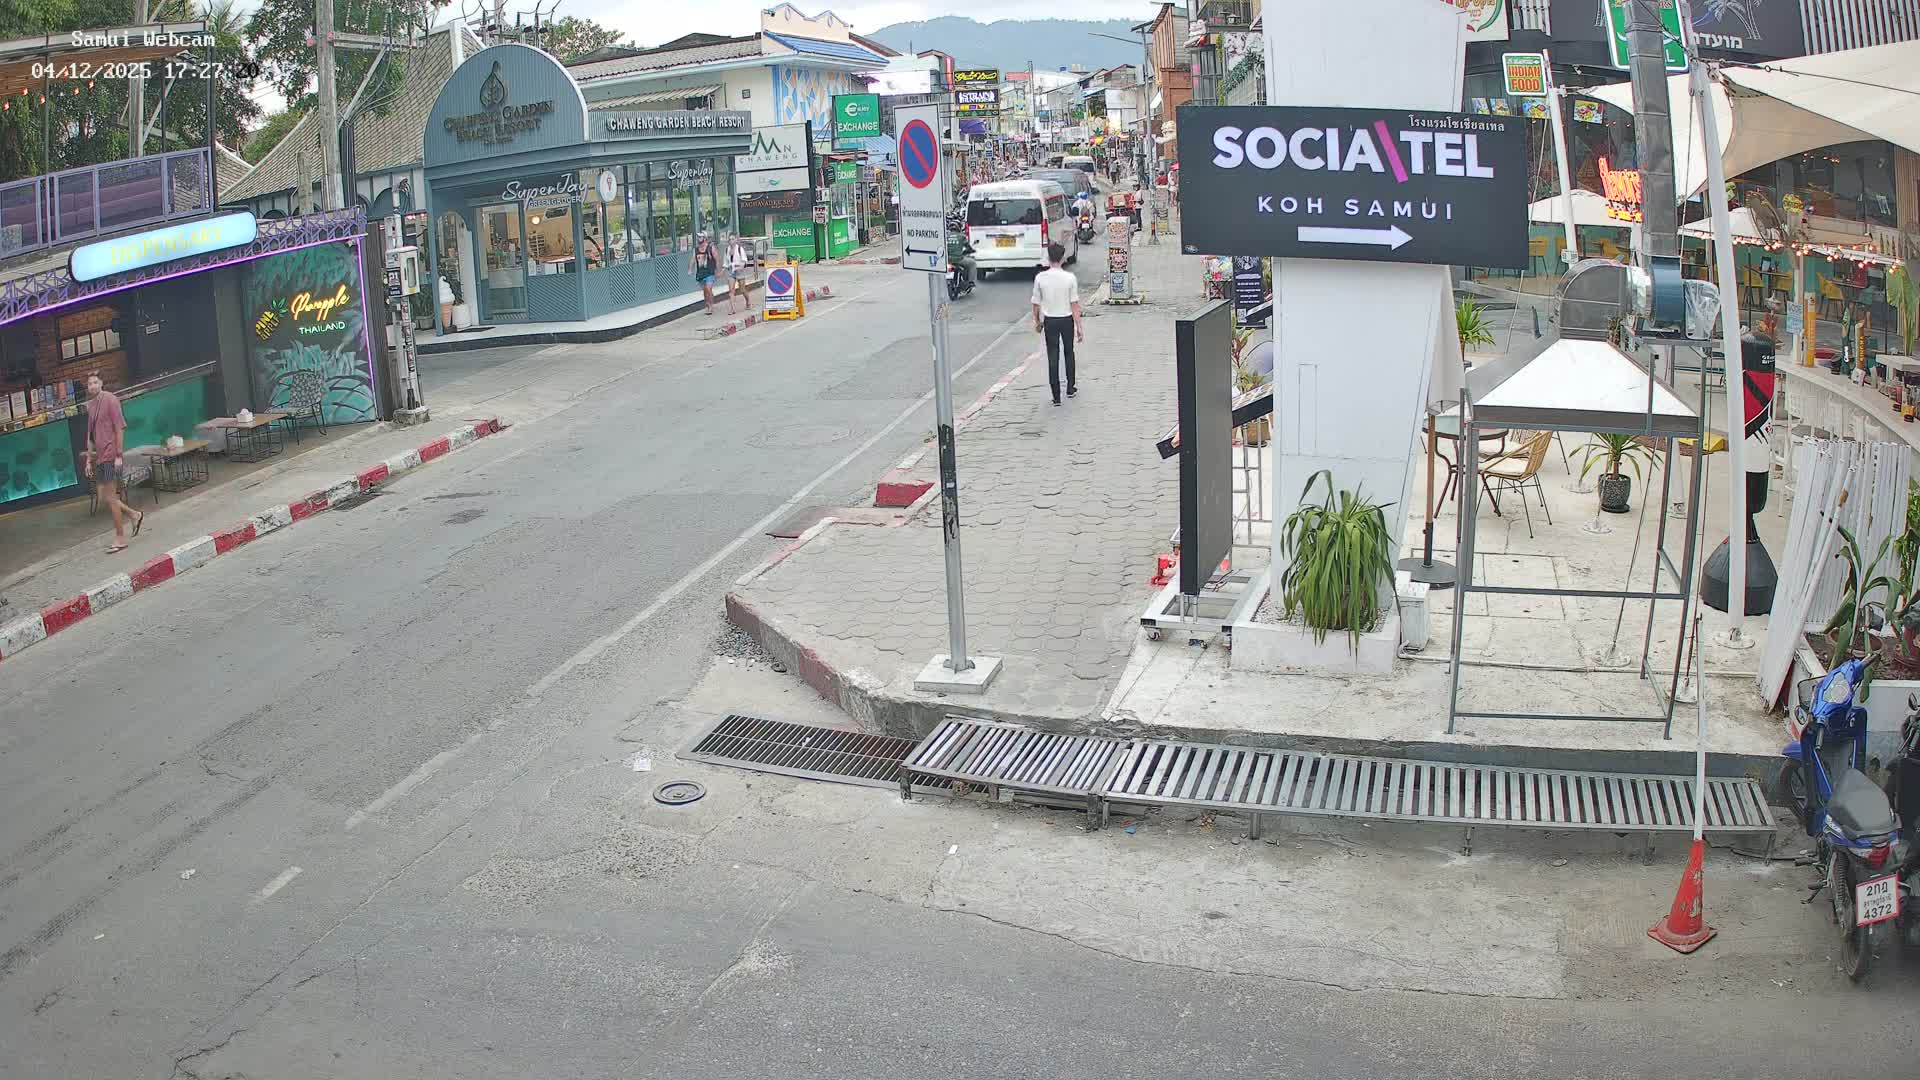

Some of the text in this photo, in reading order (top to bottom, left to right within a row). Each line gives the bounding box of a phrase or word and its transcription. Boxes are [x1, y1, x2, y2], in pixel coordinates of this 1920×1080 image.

[1508, 65, 1541, 77] INDIAN
[1511, 78, 1541, 91] FOOD
[502, 100, 556, 120] GARDEN
[610, 118, 654, 131] CHAWENG
[656, 116, 690, 128] GARDEN
[692, 116, 717, 128] BEACH
[837, 121, 879, 132] EXCHANGE
[1408, 114, 1505, 132] โรงแรมโซเชียลเทล
[738, 152, 798, 164] CHAWENG
[1258, 196, 1452, 220] KOH SAMUI
[773, 228, 812, 238] EXCHANGE
[906, 229, 939, 239] NO PARKING
[111, 225, 223, 266] DISPENSARY
[299, 321, 346, 335] THAILAND
[1864, 903, 1893, 920] 4372
